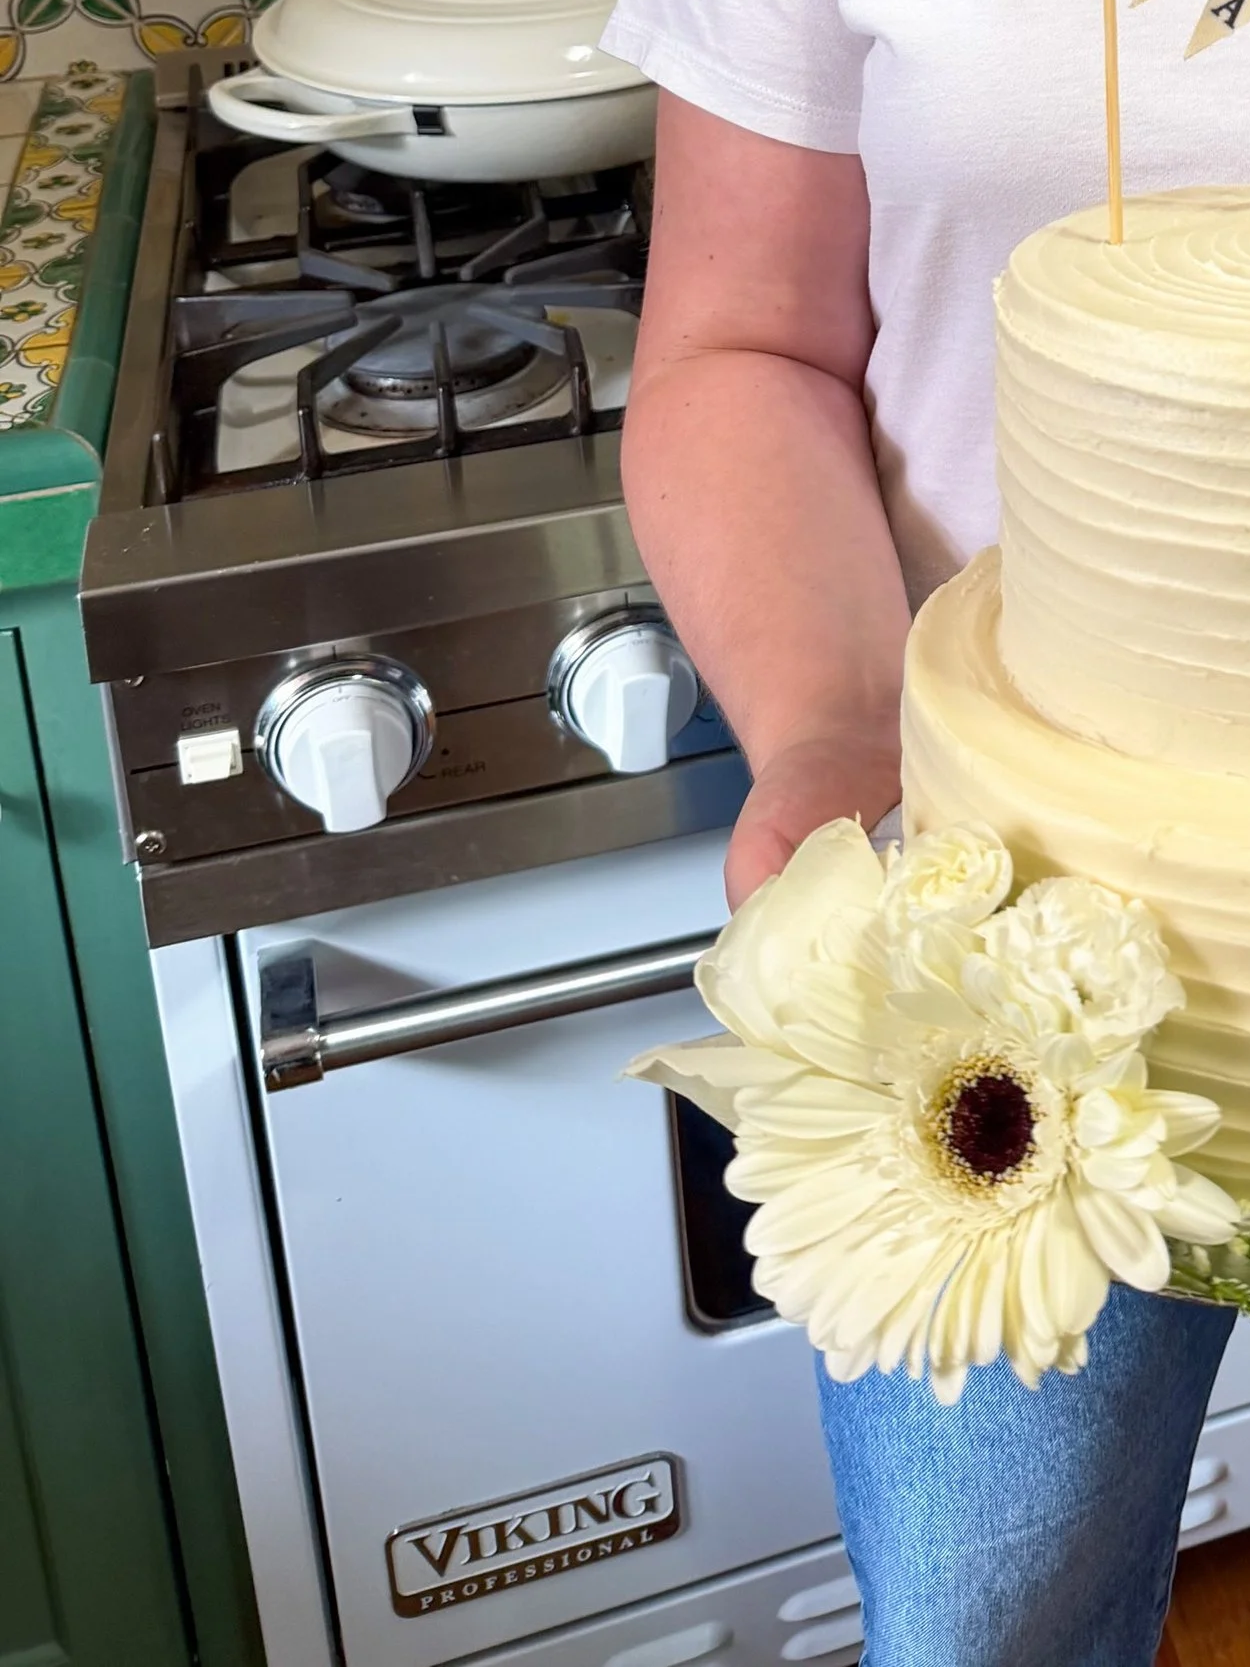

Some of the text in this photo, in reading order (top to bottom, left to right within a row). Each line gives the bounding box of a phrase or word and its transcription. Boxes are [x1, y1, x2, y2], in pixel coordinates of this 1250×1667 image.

[182, 702, 221, 717] OVEN
[180, 714, 232, 731] LIGHTS
[441, 760, 486, 778] REAR
[405, 1471, 661, 1578] VIKING
[420, 1527, 654, 1610] PROFESSIONAL
